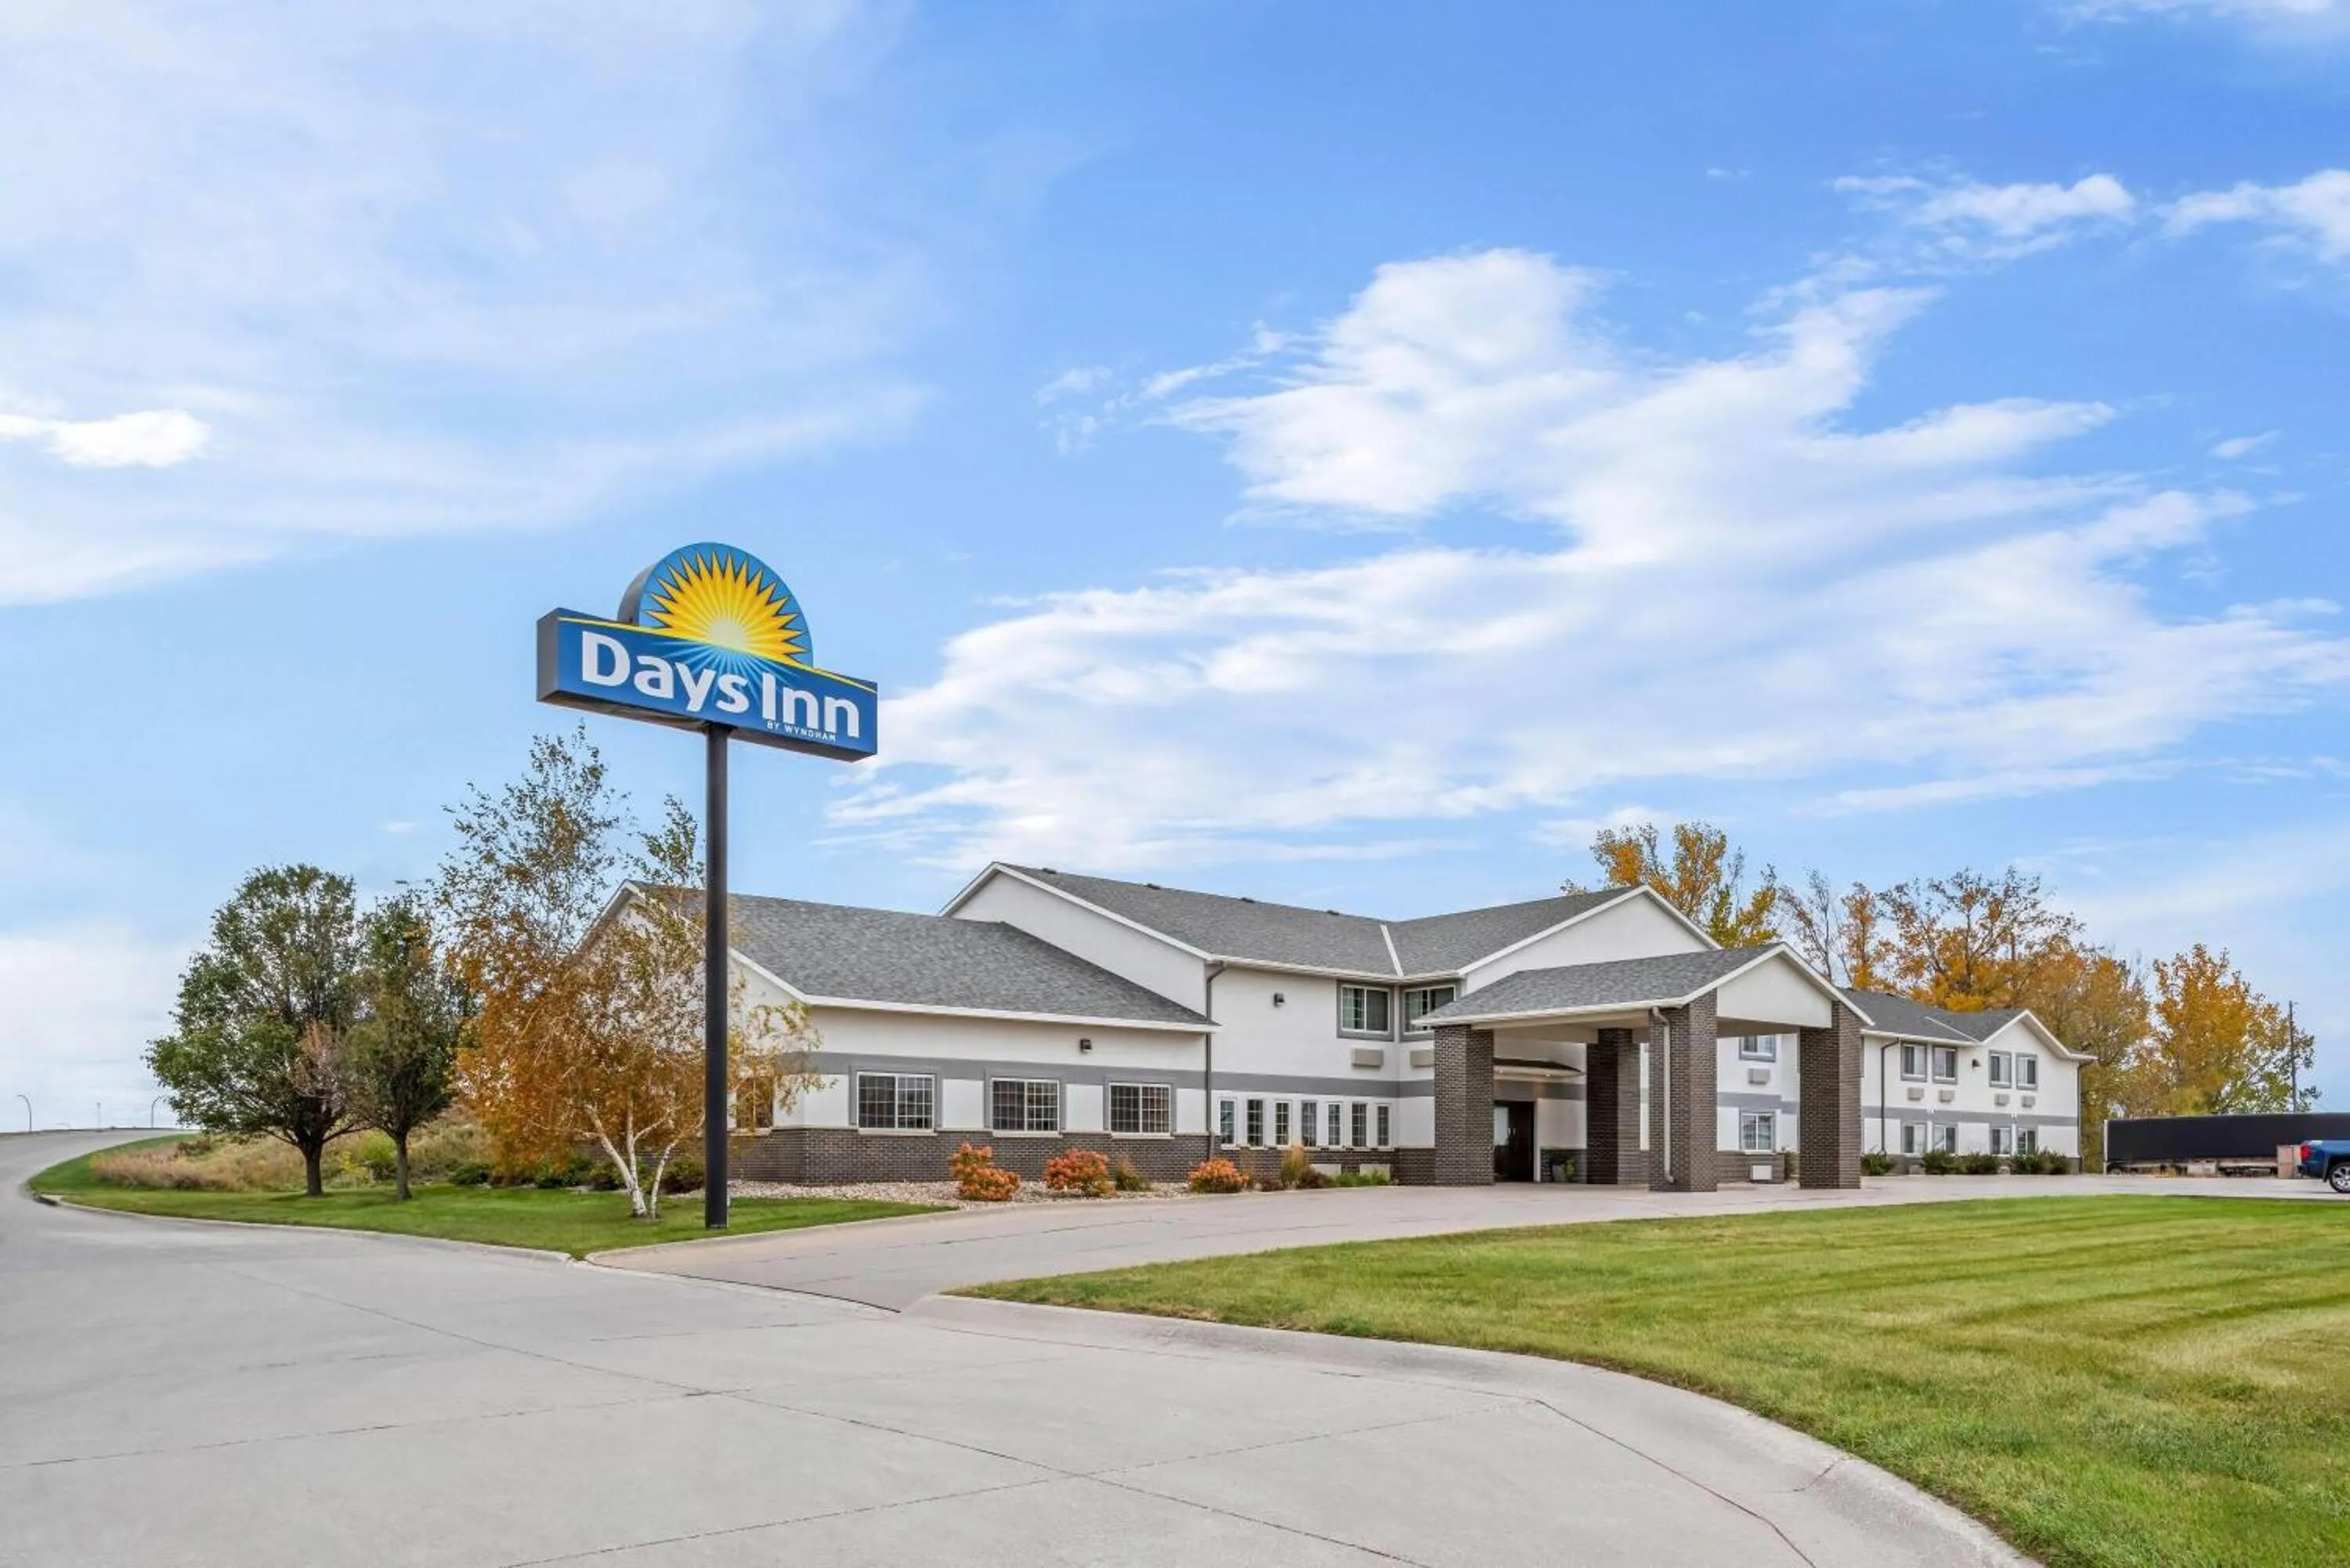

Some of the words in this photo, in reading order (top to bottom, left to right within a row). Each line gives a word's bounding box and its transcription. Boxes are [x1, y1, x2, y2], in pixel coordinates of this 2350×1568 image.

[582, 631, 749, 713] Days
[762, 673, 859, 737] Inn
[767, 720, 779, 729] BY
[784, 725, 837, 742] WYNDHAM
